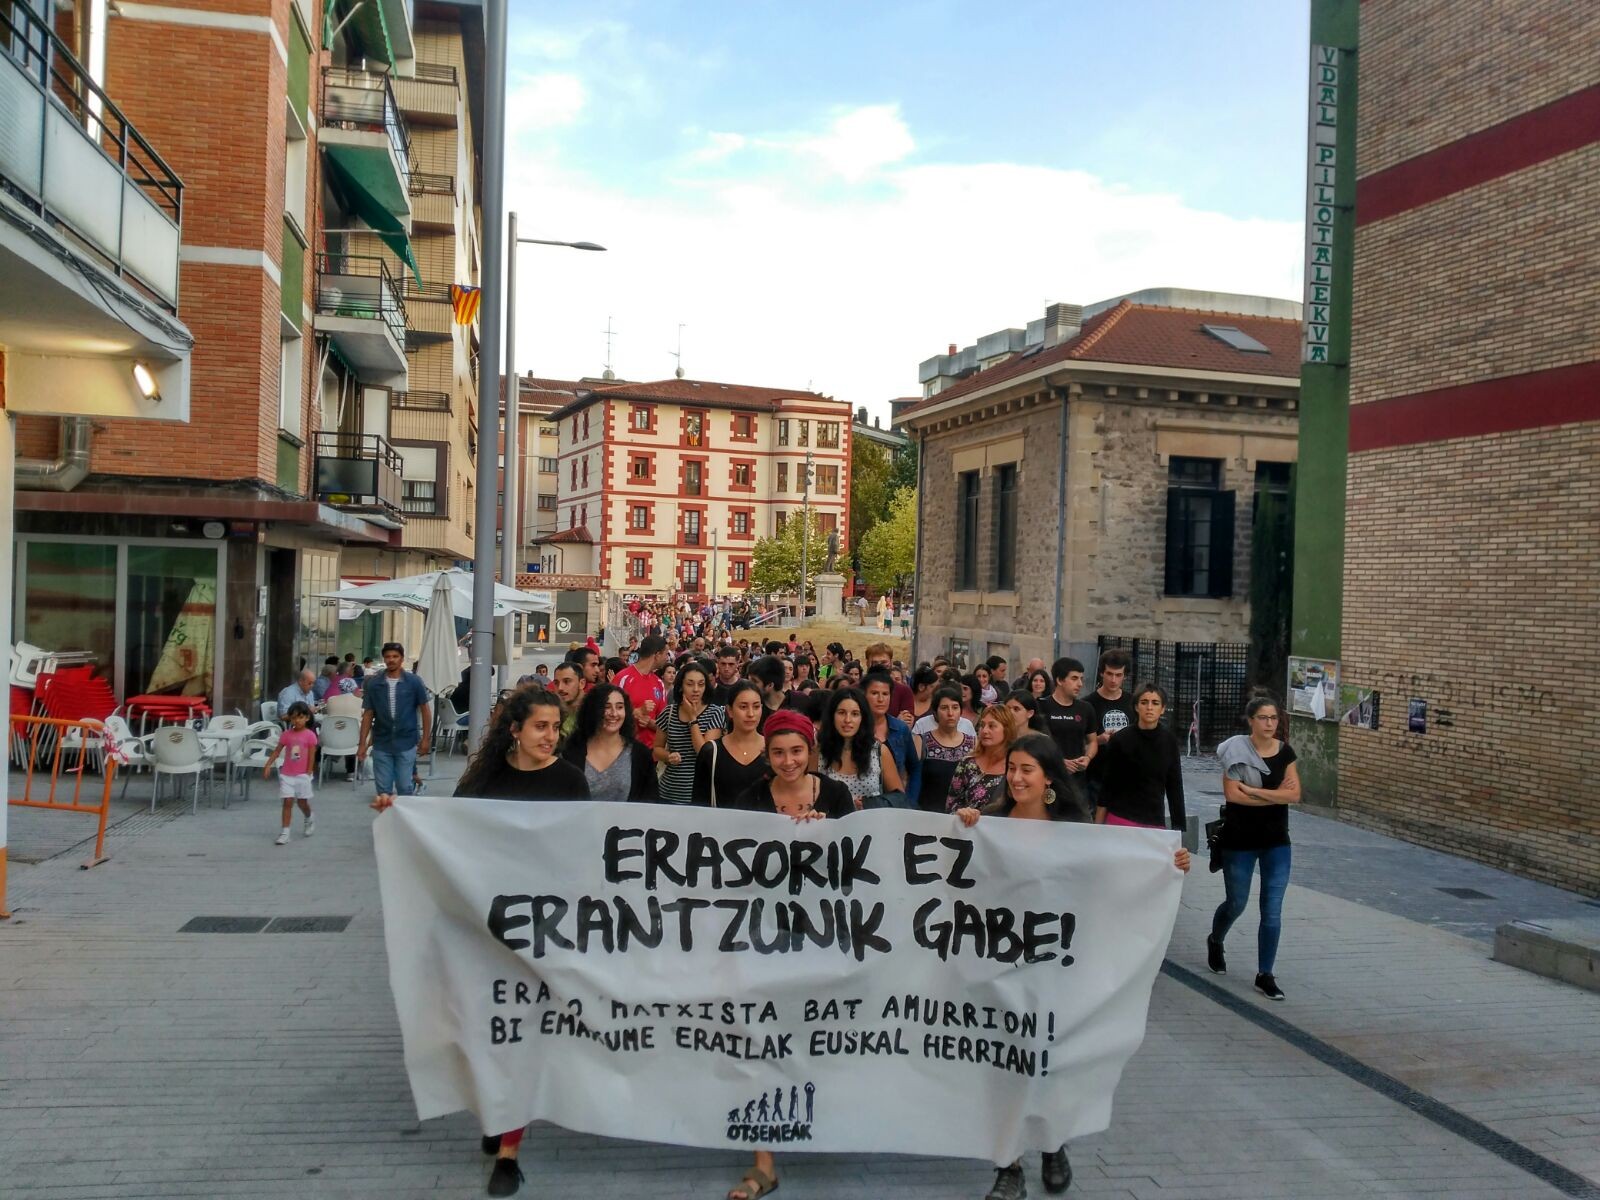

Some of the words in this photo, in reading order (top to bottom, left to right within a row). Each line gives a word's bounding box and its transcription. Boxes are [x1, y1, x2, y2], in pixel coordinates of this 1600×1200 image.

[602, 826, 880, 897] ERASORIK
[903, 832, 977, 889] EZ
[488, 894, 892, 962] ERANTZUNIK
[912, 898, 1077, 967] GABE!
[804, 998, 862, 1022] BAT
[490, 1015, 523, 1045] BI
[675, 1026, 793, 1060] ERAILAK
[809, 1027, 910, 1057] EUSKAL
[923, 1032, 1049, 1077] HERRIAN!
[726, 1121, 813, 1143] OTSEMEAK
